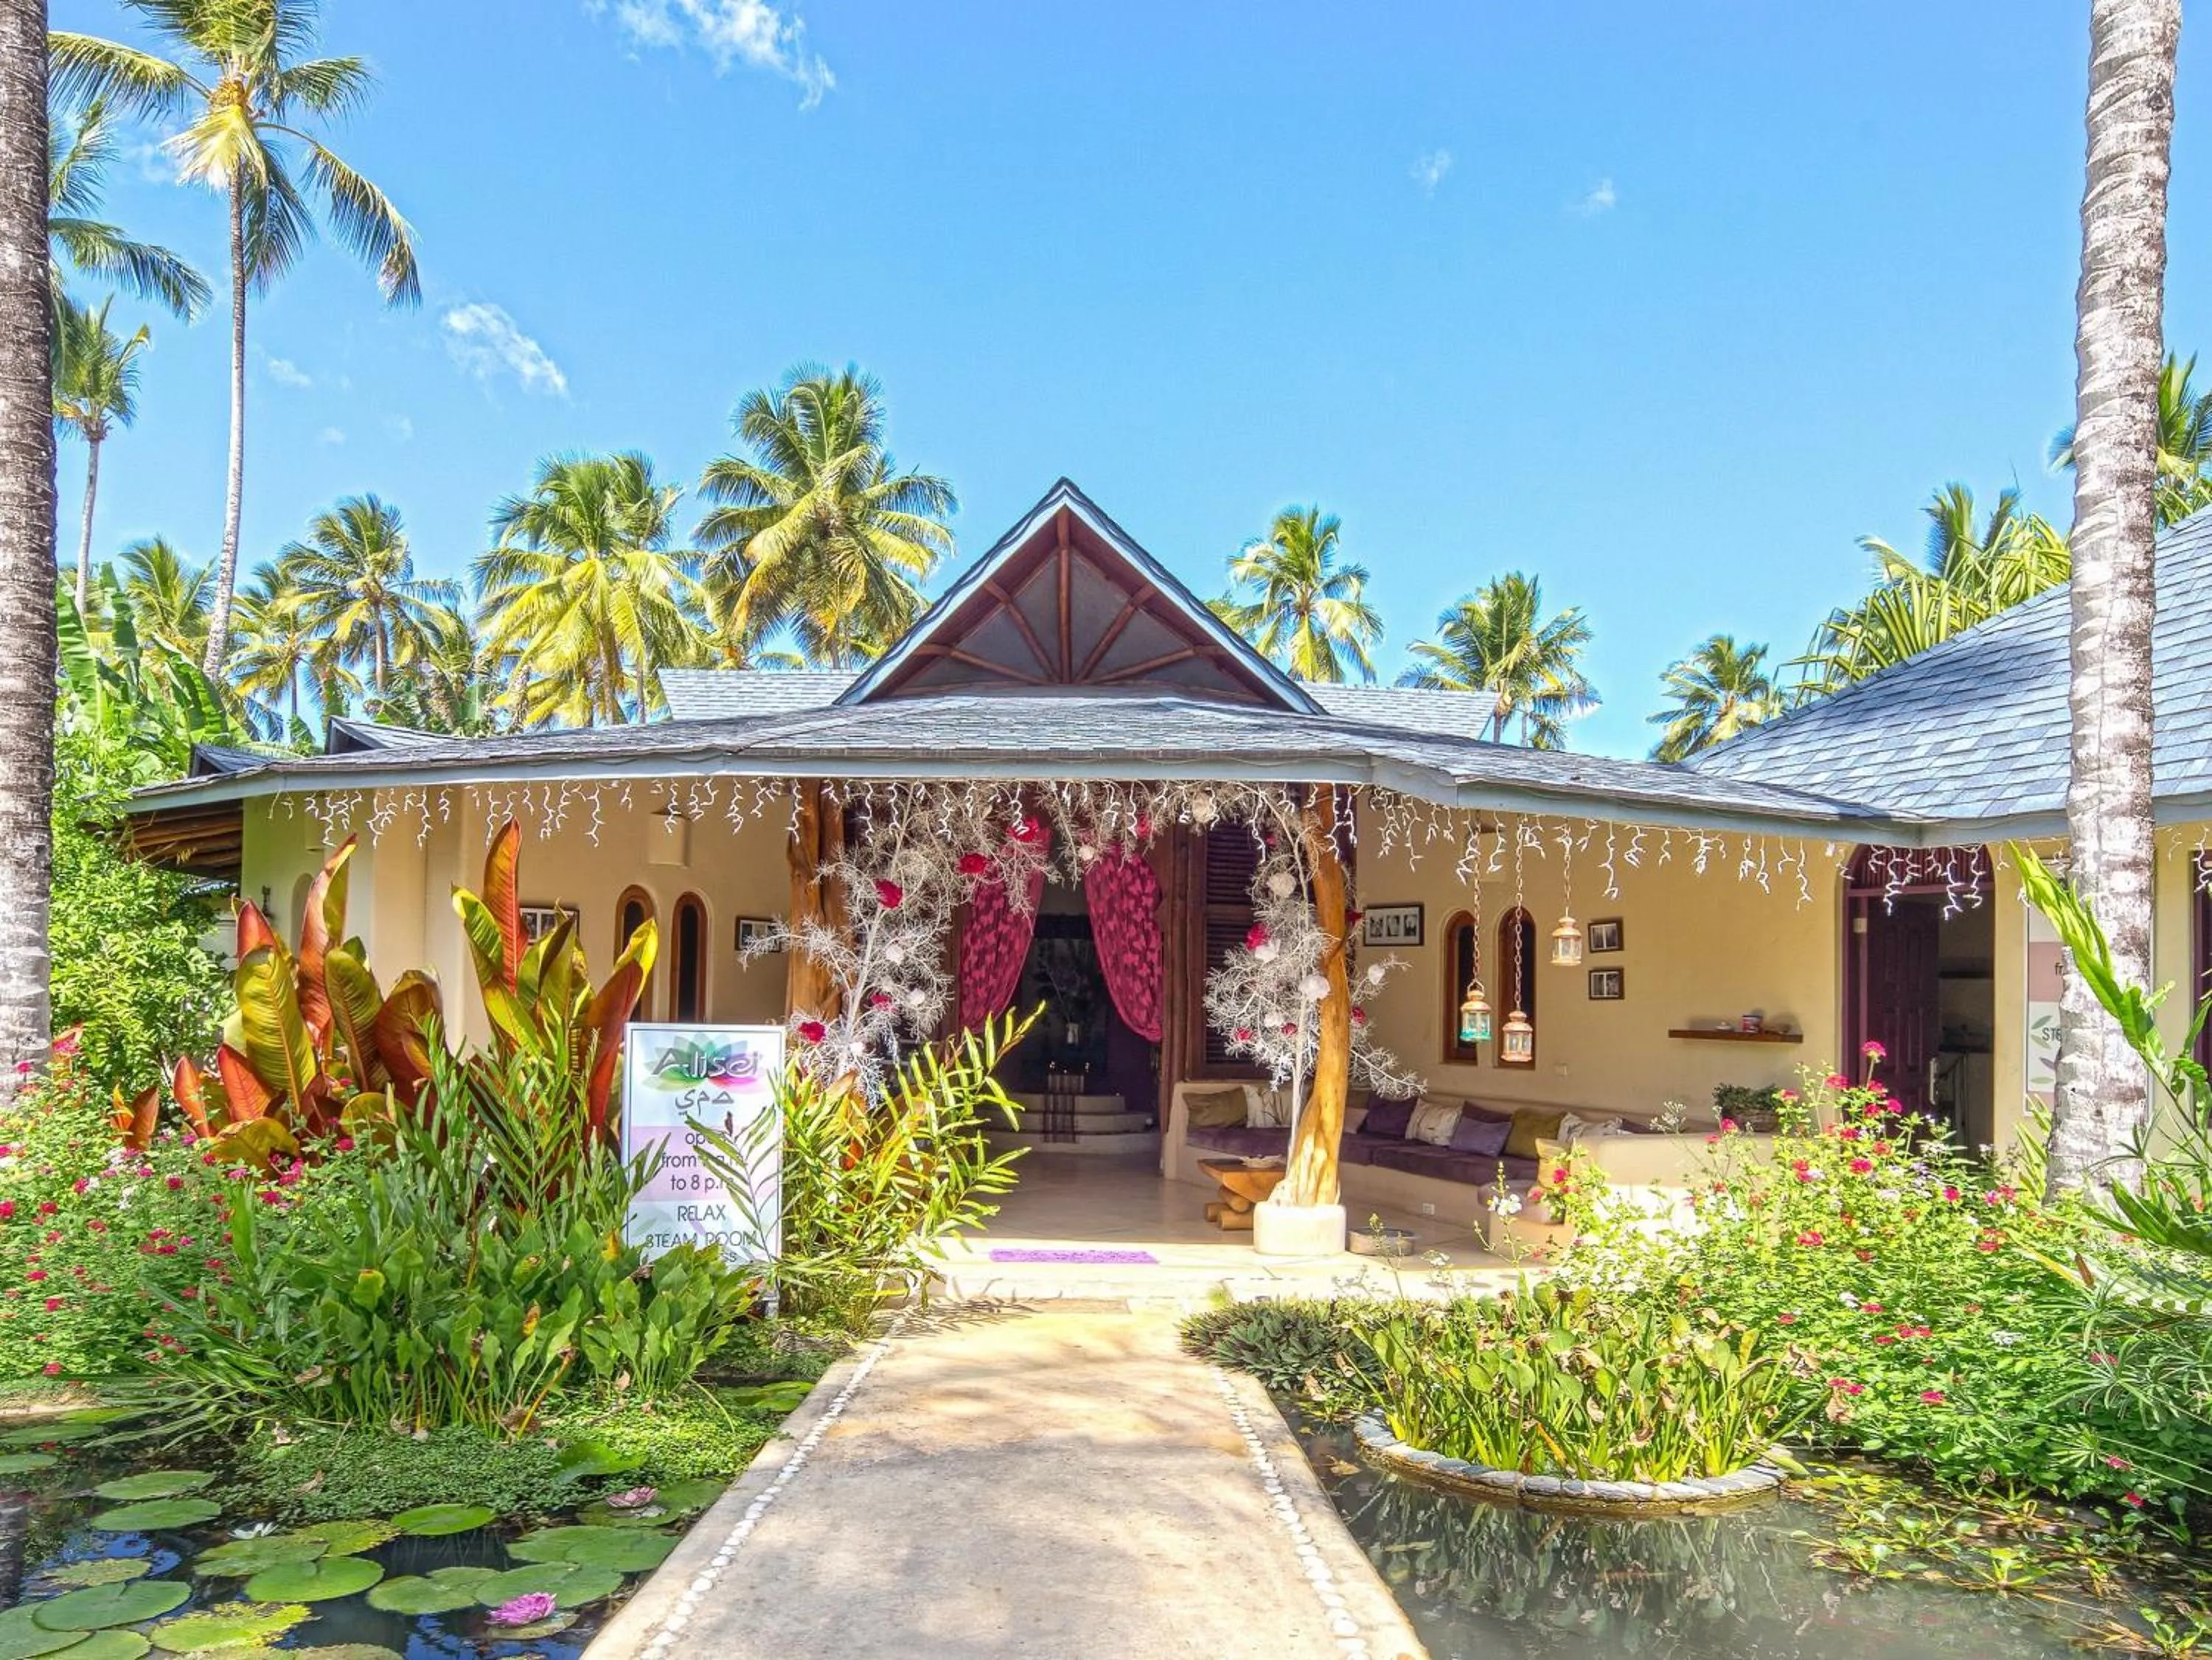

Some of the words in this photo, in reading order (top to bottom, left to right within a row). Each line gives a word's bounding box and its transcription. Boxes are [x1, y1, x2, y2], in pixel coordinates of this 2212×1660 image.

[670, 1175, 686, 1190] to
[691, 1174, 700, 1190] 8
[678, 1204, 726, 1221] RELAX
[646, 1233, 698, 1248] STEAM
[706, 1230, 757, 1246] ROOM
